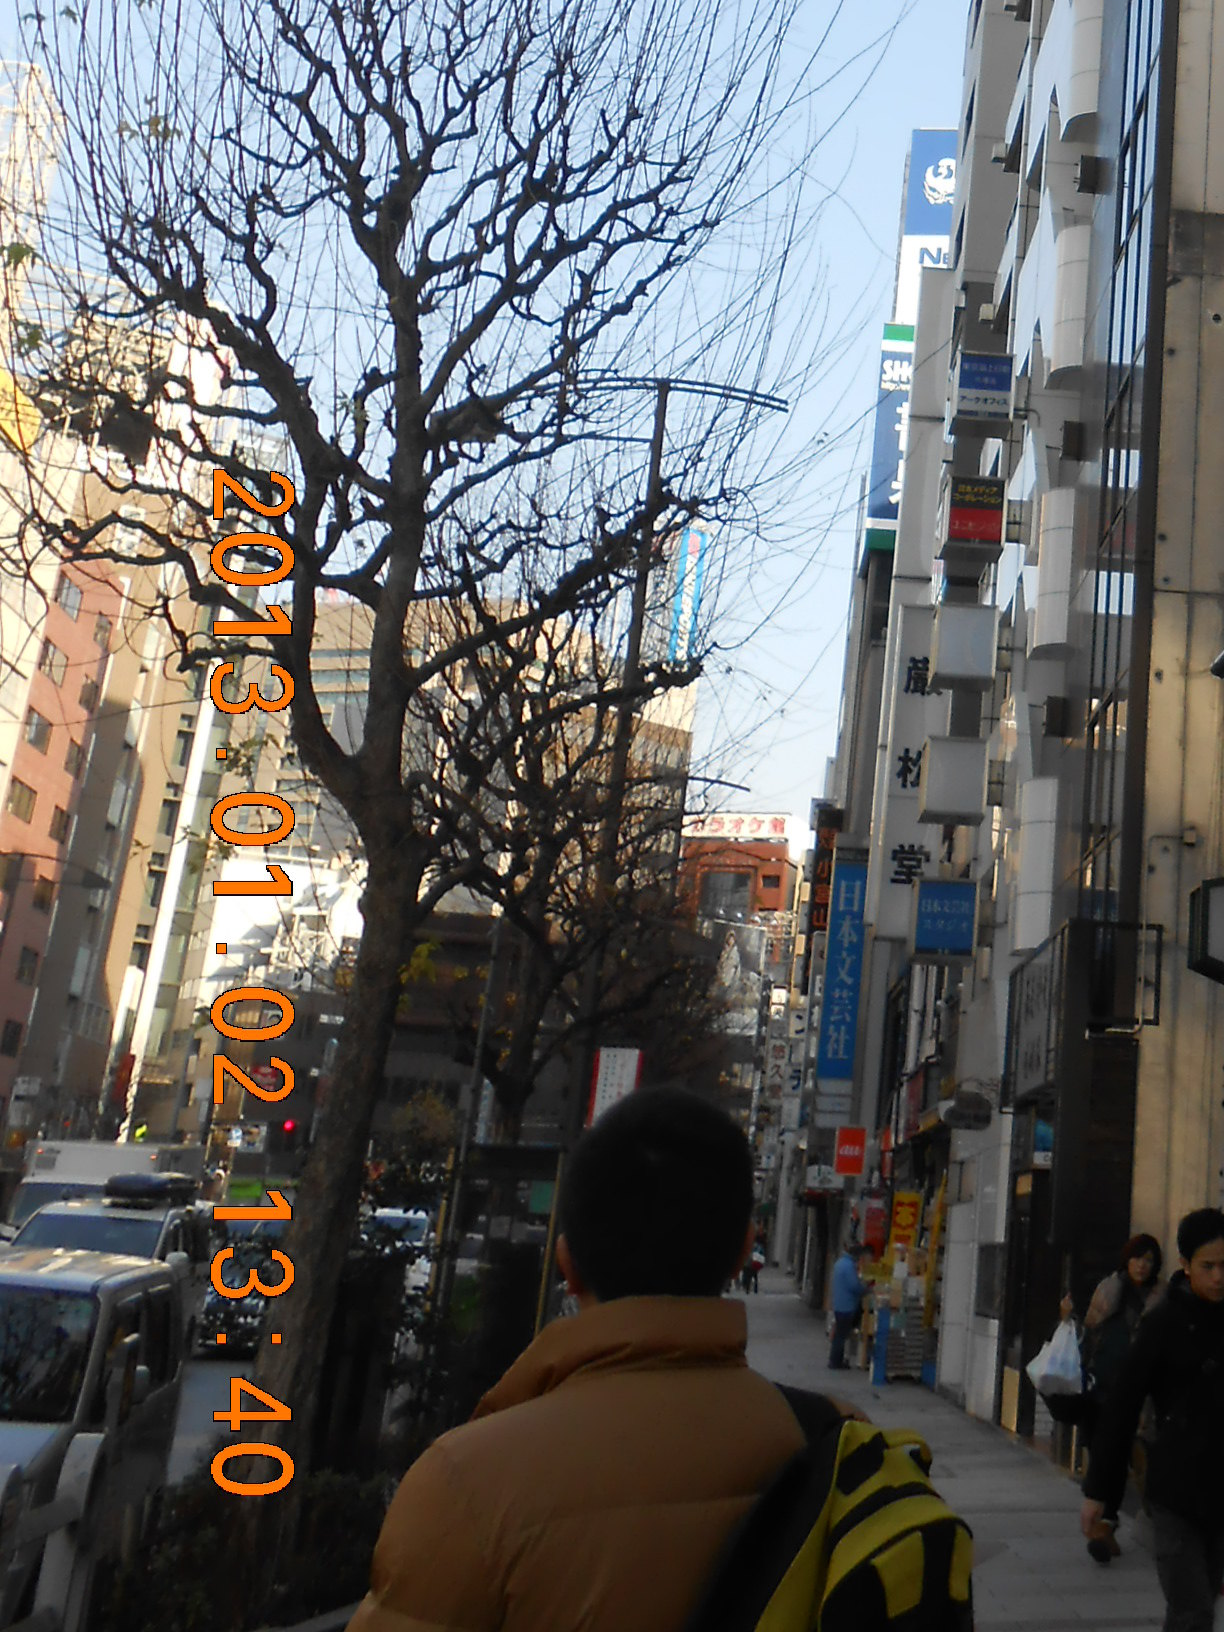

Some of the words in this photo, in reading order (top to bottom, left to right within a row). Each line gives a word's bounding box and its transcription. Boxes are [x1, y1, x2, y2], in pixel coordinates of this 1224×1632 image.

[825, 880, 861, 1060] 日本文芸社
